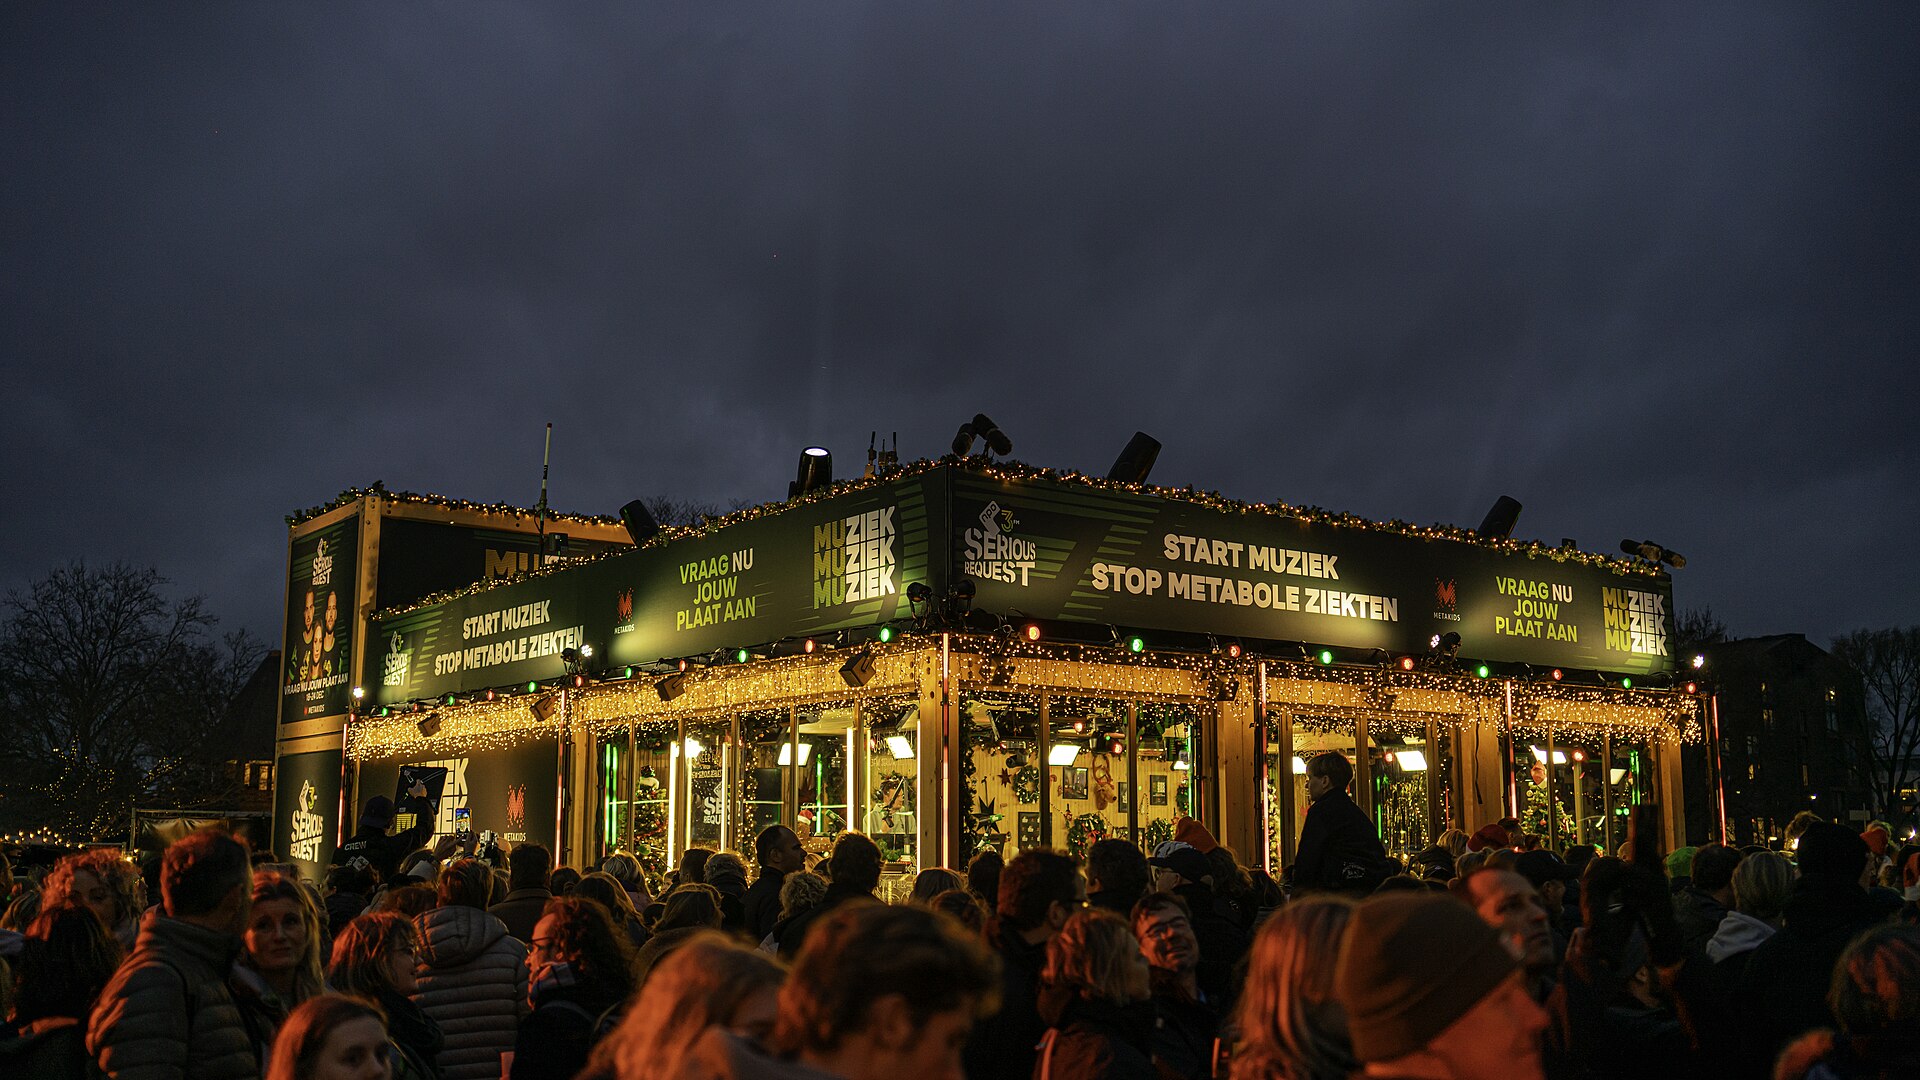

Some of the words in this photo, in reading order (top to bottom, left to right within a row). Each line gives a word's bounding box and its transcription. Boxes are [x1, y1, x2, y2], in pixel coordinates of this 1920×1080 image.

[814, 506, 895, 553] MUZIEK
[964, 527, 1036, 560] SERIOUS
[680, 554, 729, 585] VRAAG
[732, 547, 753, 573] NU
[814, 535, 895, 581] MUZIEK
[1163, 533, 1243, 568] START
[1249, 544, 1339, 580] MUZIEK
[814, 565, 895, 610] MUZIEK
[964, 561, 1036, 587] REQUEST
[693, 576, 738, 605] JOUW
[1091, 562, 1162, 596] STOP
[1168, 571, 1300, 612] METABOLE
[1305, 587, 1398, 622] ZIEKTEN
[1496, 576, 1549, 600] VRAAG
[1552, 584, 1573, 603] NU
[1602, 587, 1665, 616] MUZIEK
[463, 611, 500, 640] START
[502, 600, 551, 631] MUZIEK
[677, 603, 721, 631] PLAAT
[724, 596, 756, 622] AAN
[1433, 612, 1461, 622] METAKIDS
[1513, 599, 1558, 620] JOUW
[1603, 608, 1666, 636] MUZIEK
[1495, 616, 1543, 638] PLAAT
[1547, 622, 1578, 643] AAN
[1605, 629, 1668, 657] MUZIEK
[434, 650, 462, 676] STOP
[463, 635, 527, 671] METABOLE
[529, 625, 584, 659] ZIEKTEN
[284, 683, 301, 696] VRAAG
[308, 679, 322, 691] JOUW
[322, 675, 338, 688] PLAAT
[338, 672, 349, 685] AAN
[291, 810, 323, 842] SERIOUS
[344, 841, 367, 851] CREW
